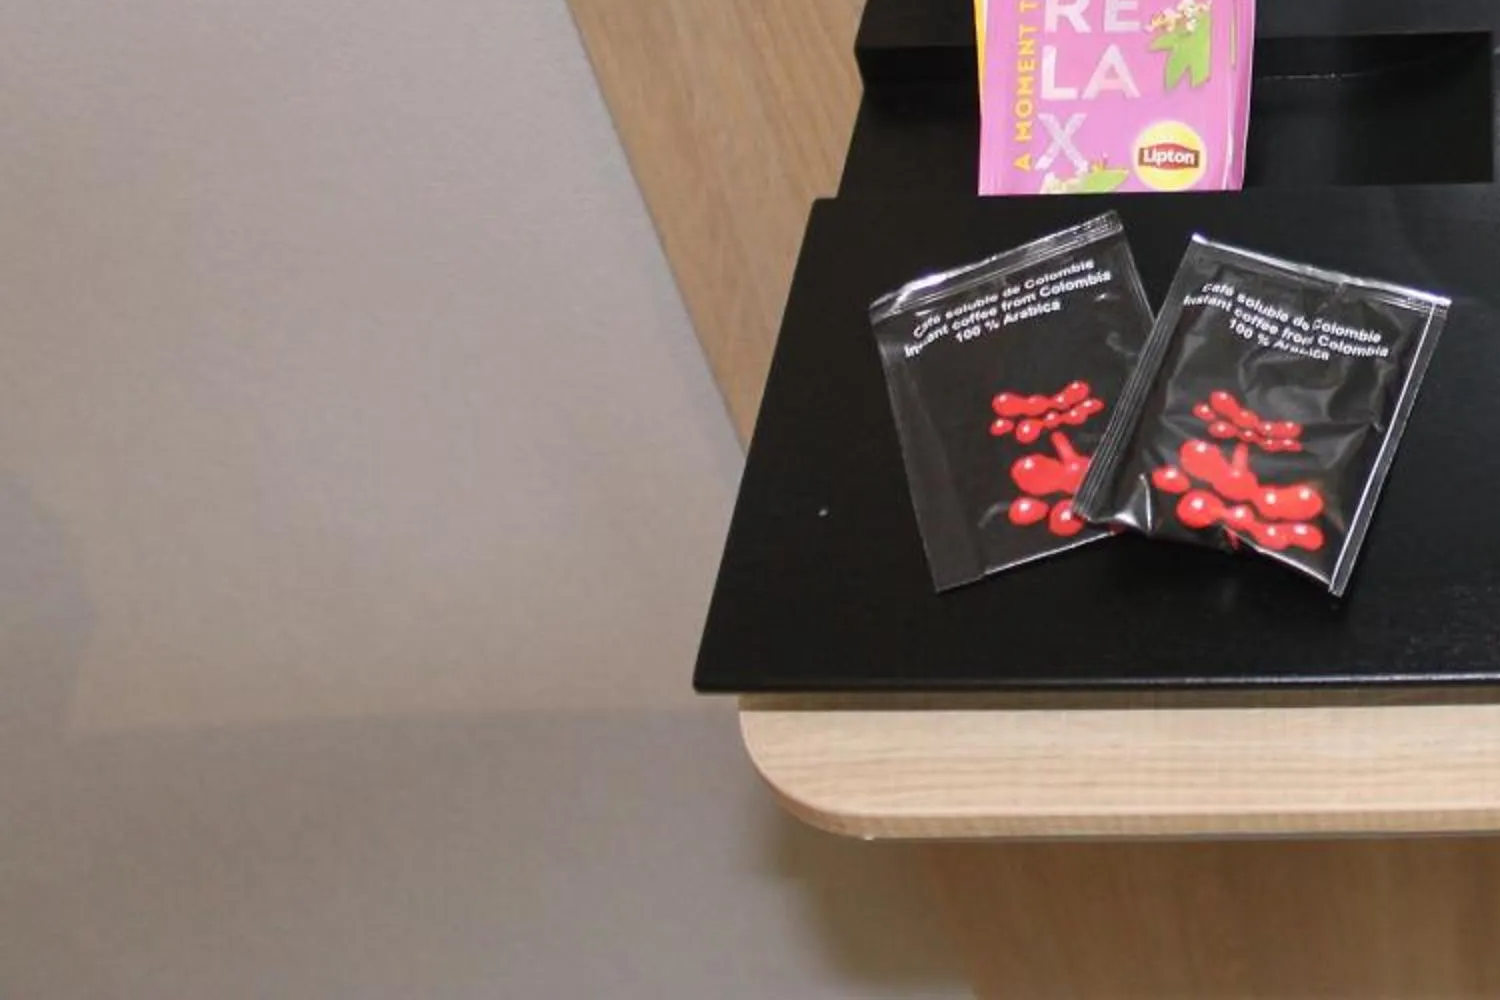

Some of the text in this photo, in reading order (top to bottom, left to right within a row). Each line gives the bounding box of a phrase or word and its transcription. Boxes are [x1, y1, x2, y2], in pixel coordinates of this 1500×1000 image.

[1015, 24, 1038, 141] MOMENT
[1013, 155, 1032, 172] A
[1142, 146, 1196, 169] Lipton
[904, 270, 1111, 358] Inant coffee from Colombia
[945, 293, 999, 320] soluble
[1003, 284, 1020, 298] de
[1024, 259, 1095, 289] Colombie
[956, 300, 1061, 343] 100 % Arabica
[1229, 318, 1253, 339] 100
[1257, 333, 1270, 347] %
[1234, 307, 1279, 335] coffee
[1317, 335, 1389, 358] Colombia
[1237, 293, 1289, 323] soluble
[1292, 315, 1310, 332] de
[1312, 319, 1381, 344] Colombie
